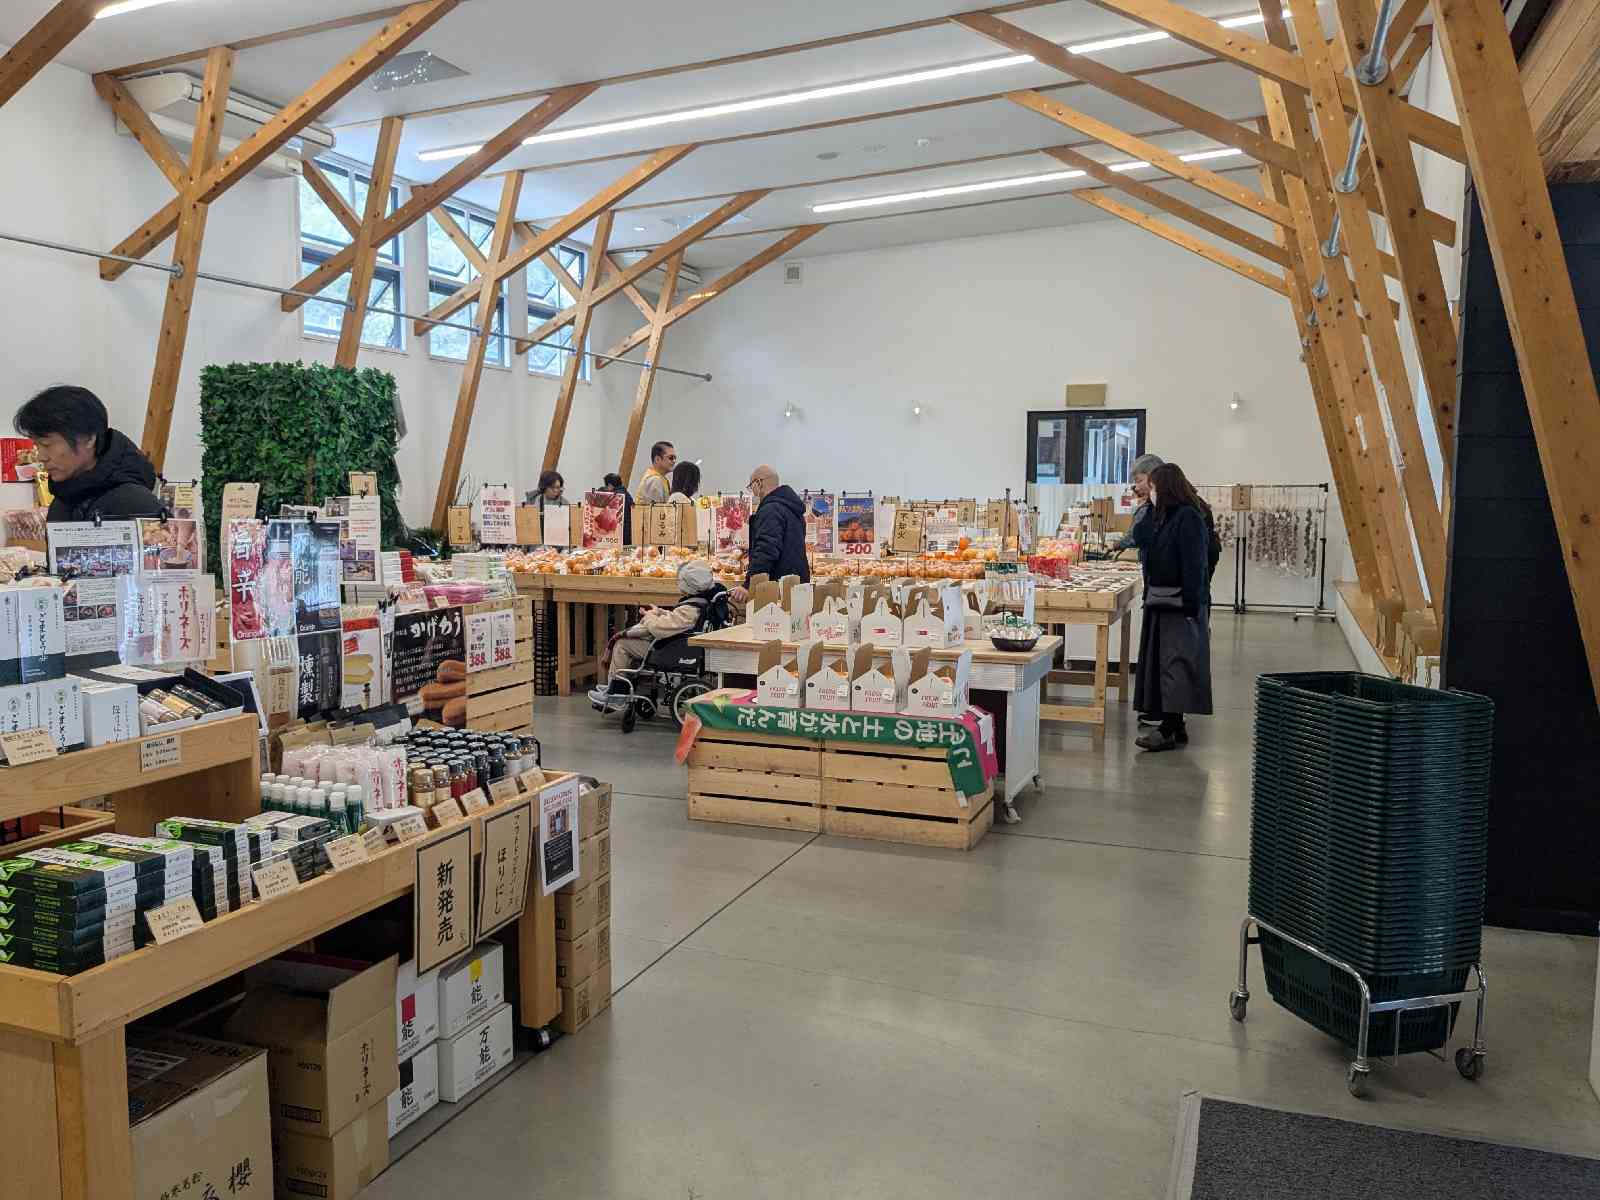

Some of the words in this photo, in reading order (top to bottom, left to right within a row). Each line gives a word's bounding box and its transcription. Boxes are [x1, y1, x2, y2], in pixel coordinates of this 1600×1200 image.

[846, 543, 872, 555] 500
[436, 859, 454, 947] 新発売
[479, 1025, 492, 1065] 万能
